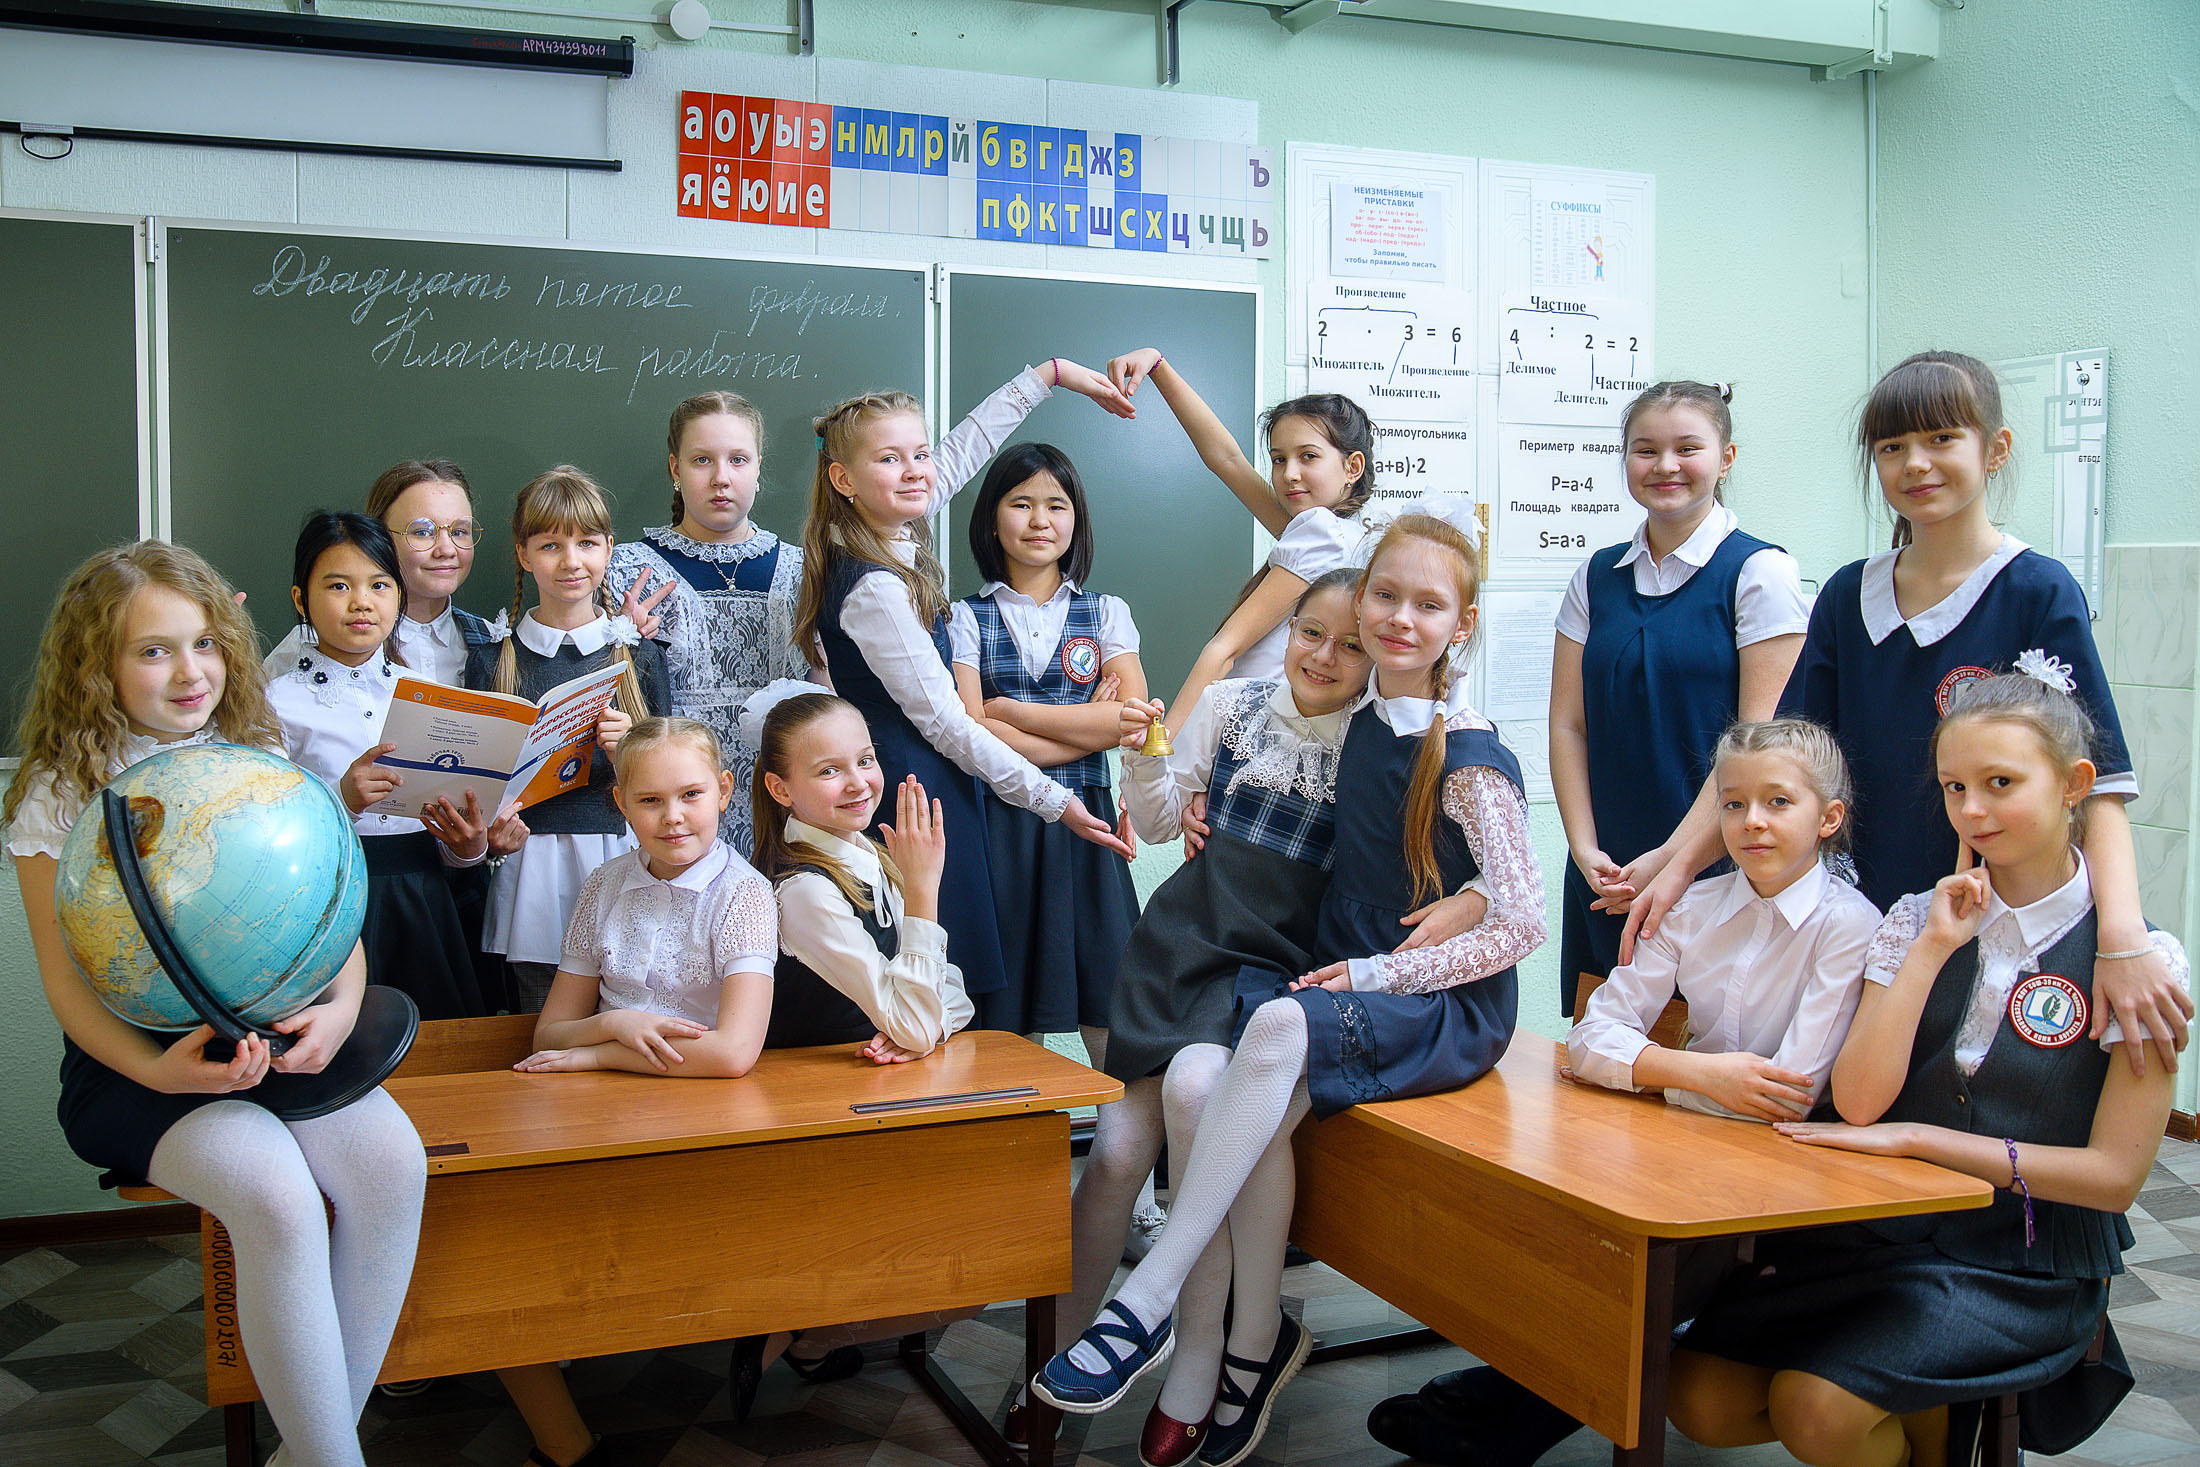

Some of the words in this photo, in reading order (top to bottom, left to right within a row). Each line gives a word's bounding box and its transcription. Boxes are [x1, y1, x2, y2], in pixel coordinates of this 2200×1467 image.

[1353, 186, 1424, 199] НЕИЗМЕНЯЕМЫЕ
[1364, 197, 1415, 208] ПРИСТАВКИ
[1550, 201, 1601, 214] СУФФИКСЫ
[1372, 248, 1408, 259] Запомни,
[1344, 256, 1368, 265] чтобы
[1369, 258, 1410, 268] правильно
[1411, 261, 1437, 269] писать
[252, 245, 512, 325] Двадцать
[535, 275, 693, 309] пятое
[1335, 285, 1407, 299] Произведение
[1530, 295, 1587, 313] Частное
[1318, 320, 1328, 337] 2
[1404, 324, 1414, 341] 3
[1451, 327, 1461, 343] 6
[371, 306, 619, 373] Классная
[1509, 328, 1520, 345] 4
[1585, 334, 1594, 350] 2
[1629, 336, 1638, 352] 2
[1311, 356, 1385, 371] Множитель
[1401, 364, 1470, 377] Произведение
[1505, 361, 1557, 376] Делимое
[1595, 376, 1649, 391] Частное
[1368, 384, 1441, 399] Множитель
[1554, 390, 1609, 406] Делитель
[1372, 427, 1467, 441] прямоугольника
[1519, 439, 1575, 454] Периметр
[1582, 442, 1624, 455] квадра
[1510, 500, 1562, 515] Площадь
[1570, 503, 1620, 514] квадрата
[529, 690, 613, 739] ВСЕРОССИЙСКИЕ
[531, 701, 608, 746] ПРОВЕРОЧНЫЕ
[536, 727, 595, 762] МАТЕМАТИКА
[437, 756, 454, 769] 4
[562, 760, 577, 777] 4
